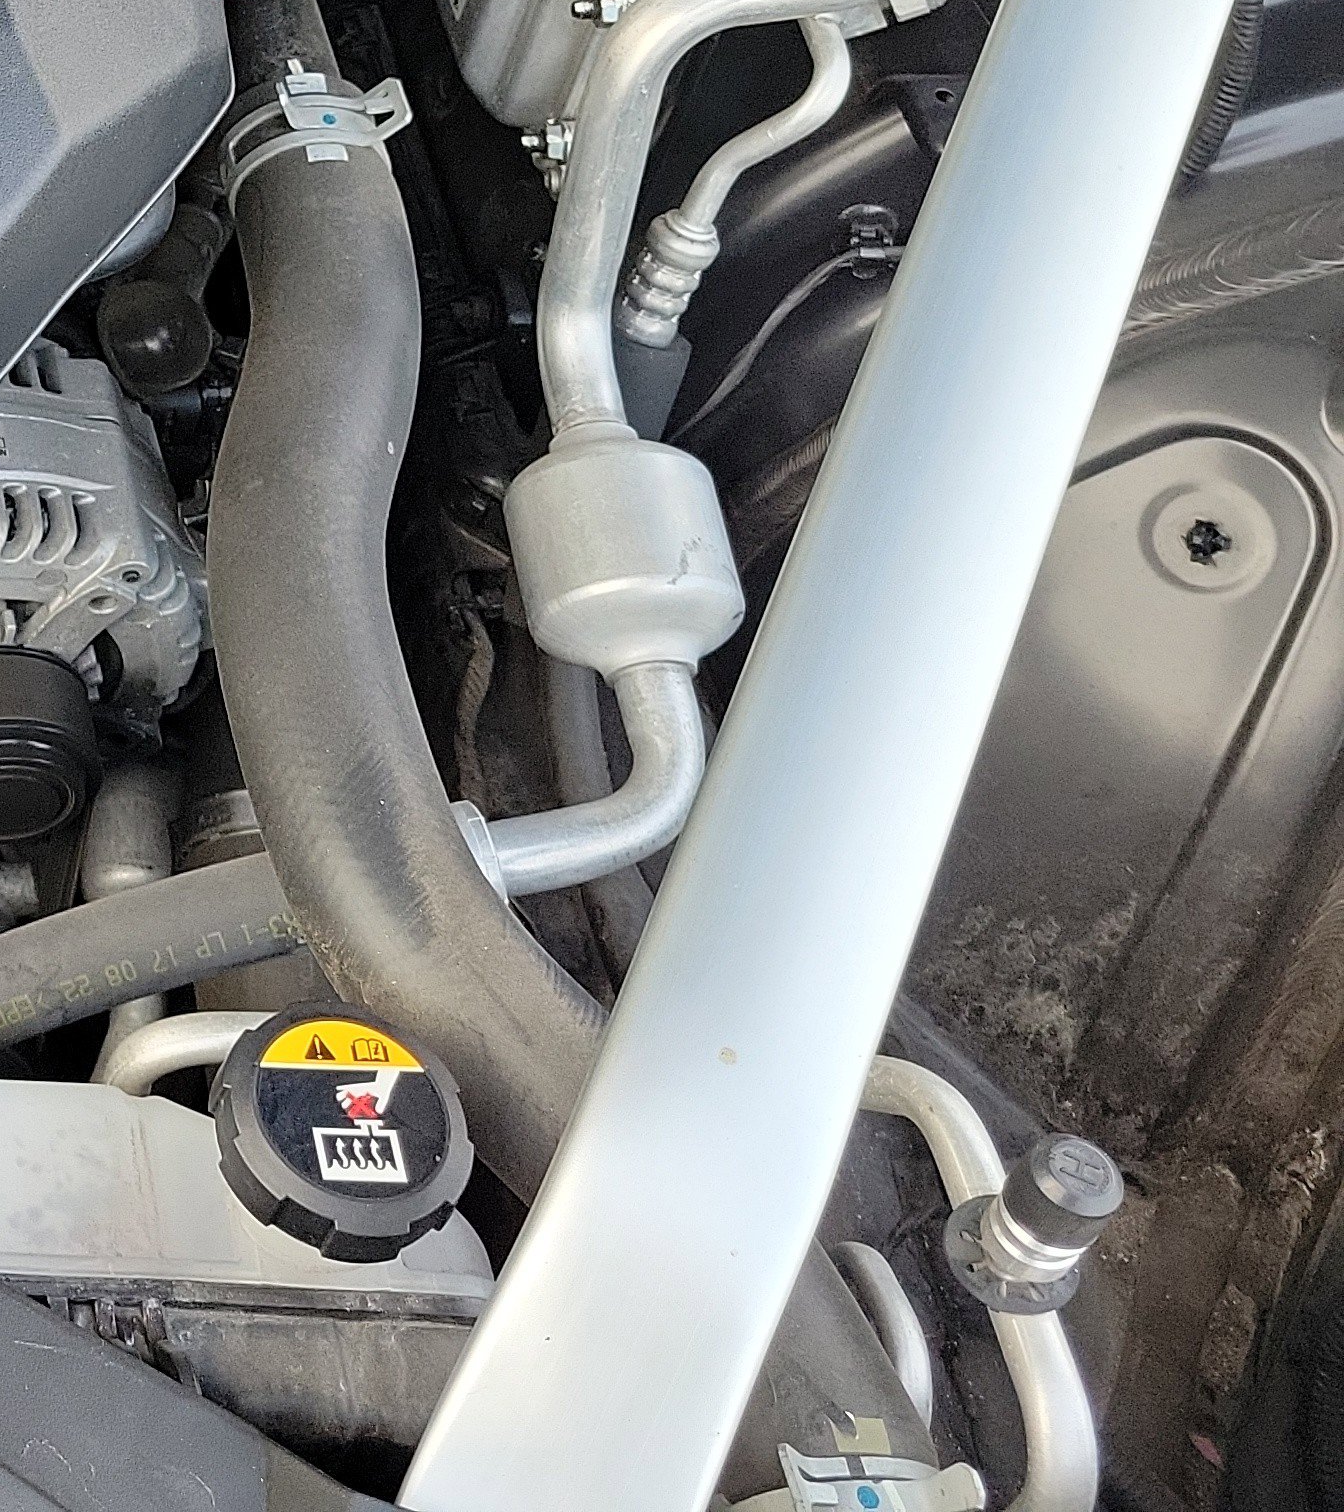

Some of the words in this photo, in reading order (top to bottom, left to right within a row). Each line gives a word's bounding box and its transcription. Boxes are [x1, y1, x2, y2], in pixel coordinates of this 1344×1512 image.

[195, 931, 228, 958] LP
[105, 960, 137, 987] 08
[59, 974, 93, 1002] 22
